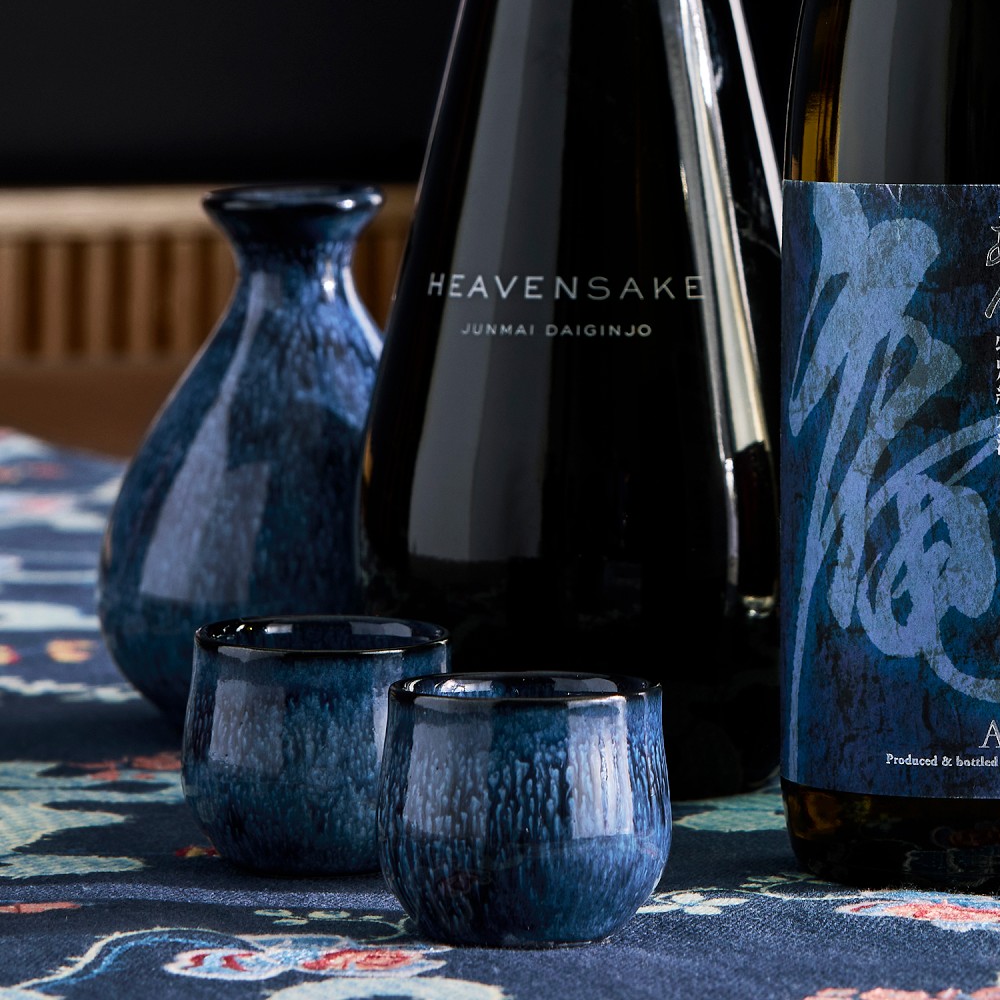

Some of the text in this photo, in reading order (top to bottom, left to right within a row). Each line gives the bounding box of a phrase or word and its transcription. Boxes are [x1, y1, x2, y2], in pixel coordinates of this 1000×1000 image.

[427, 272, 706, 300] HEAVENSAKE
[461, 323, 652, 337] JUNMAI DAIGINJO
[886, 753, 938, 767] Produced
[941, 755, 952, 768] &
[955, 755, 998, 767] bottled
